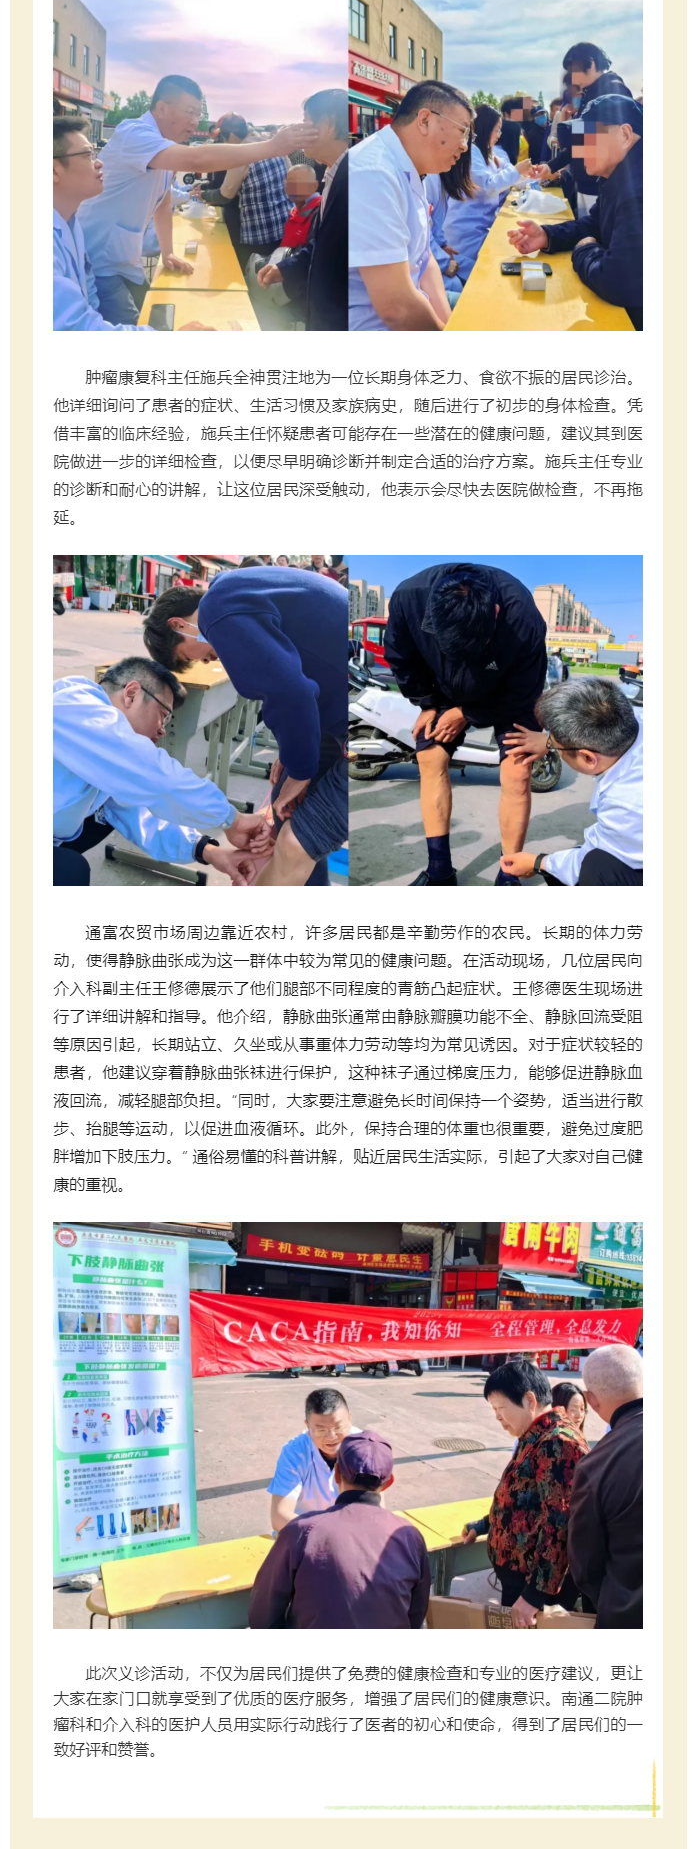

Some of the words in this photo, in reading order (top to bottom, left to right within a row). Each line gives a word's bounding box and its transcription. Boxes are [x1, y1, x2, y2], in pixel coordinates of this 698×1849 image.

[67, 1253, 165, 1273] 下肢静脉曲张
[259, 1238, 345, 1261] 手机变砝码
[356, 1252, 423, 1265] 计量惠民生
